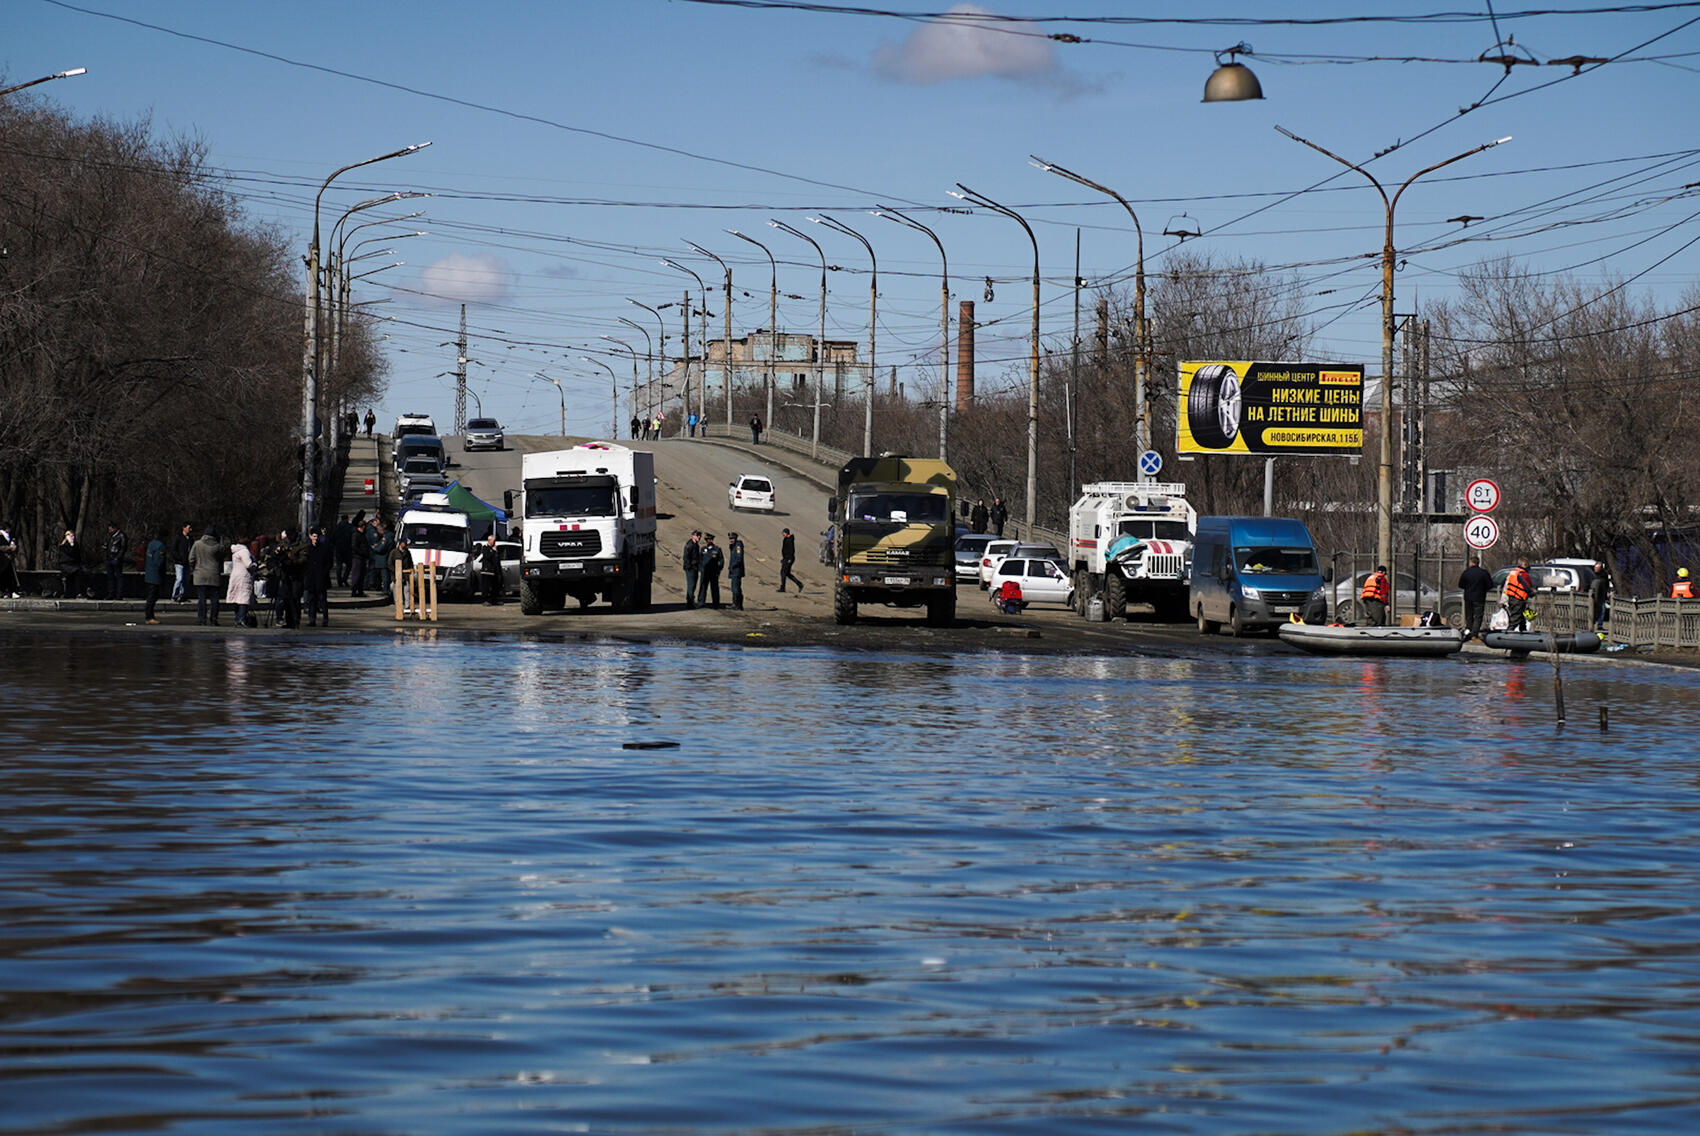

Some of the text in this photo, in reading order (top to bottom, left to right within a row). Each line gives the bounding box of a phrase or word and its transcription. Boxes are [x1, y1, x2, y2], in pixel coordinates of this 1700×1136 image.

[1257, 371, 1316, 383] ШИННЫЙ ЦЕНТР
[1272, 388, 1360, 405] НИЗКИЕ ЦЕНЫ
[1247, 406, 1360, 423] НА ЛЕТНИЕ ШИНЫ
[1471, 526, 1491, 539] 40
